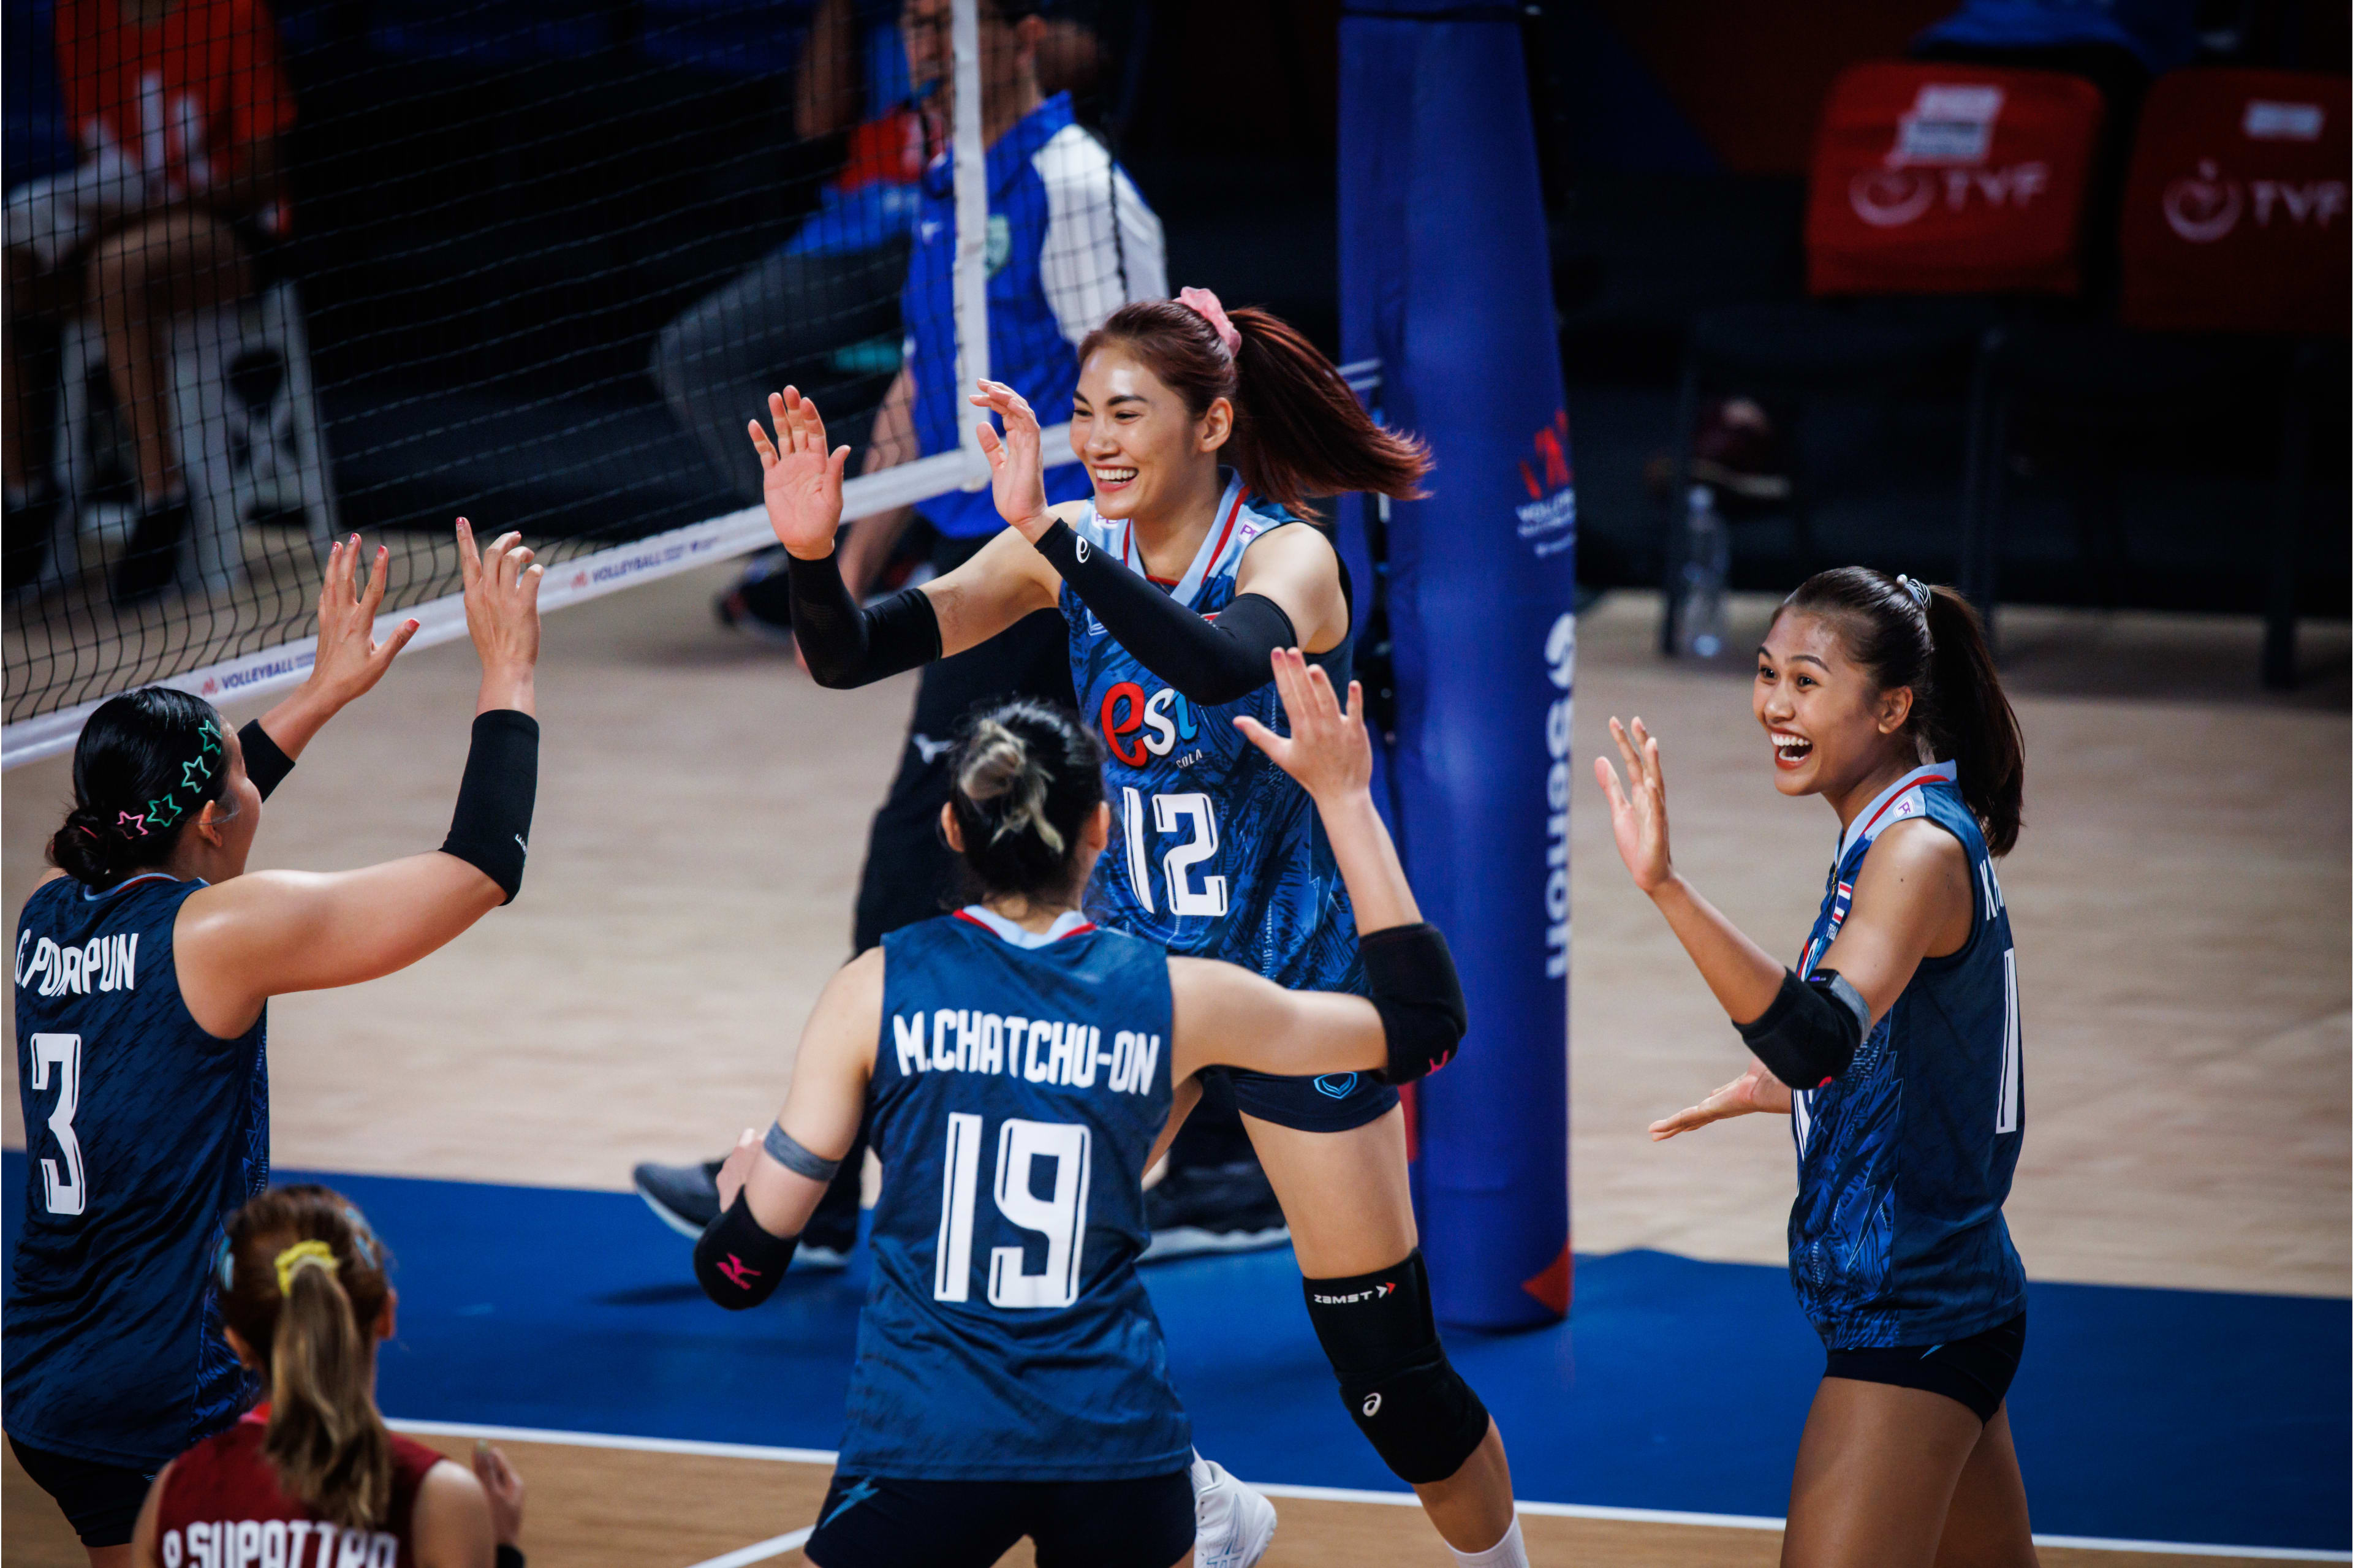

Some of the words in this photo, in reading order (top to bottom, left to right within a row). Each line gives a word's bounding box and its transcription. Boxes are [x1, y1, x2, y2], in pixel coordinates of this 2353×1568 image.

[592, 552, 662, 583] VOLLEYBALL
[221, 657, 294, 689] VOLLEYBALL
[1176, 748, 1203, 768] COLA
[1122, 786, 1229, 917] 12
[893, 1009, 1161, 1096] M.CHATCHU-ON
[30, 1032, 86, 1216] 3
[934, 1112, 1091, 1308] 19
